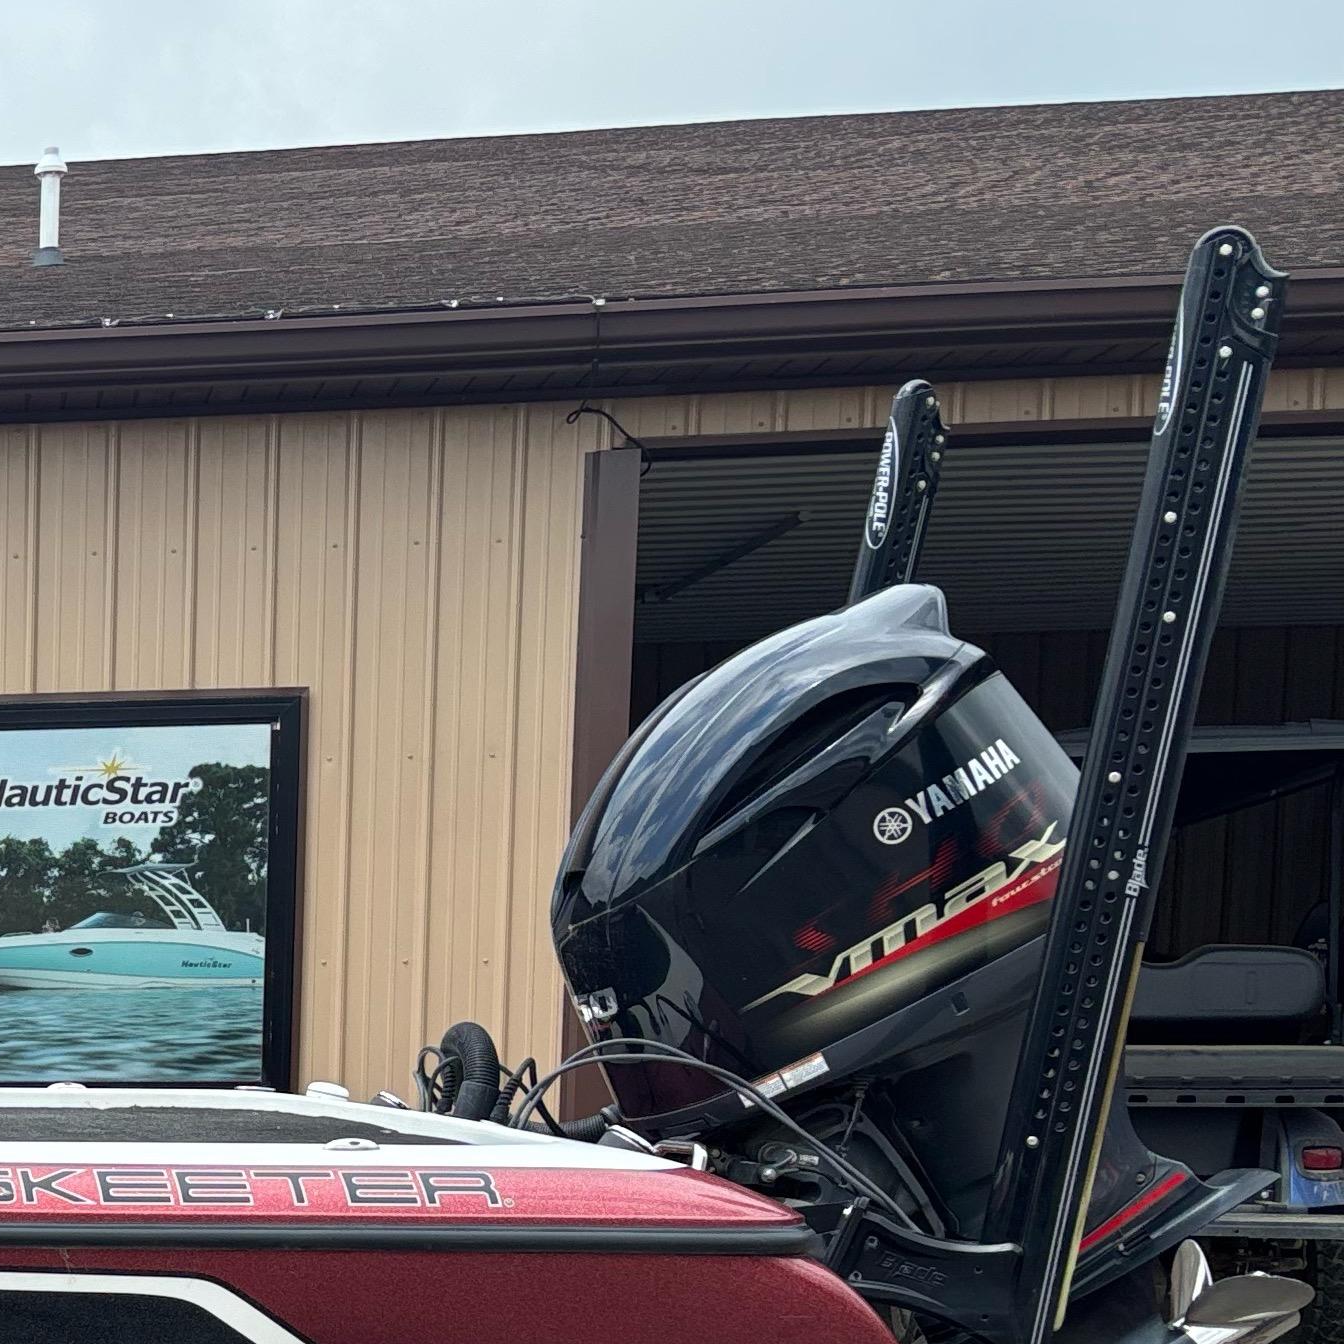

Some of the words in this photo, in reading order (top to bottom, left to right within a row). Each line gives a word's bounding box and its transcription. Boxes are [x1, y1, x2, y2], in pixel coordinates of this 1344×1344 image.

[872, 431, 893, 531] POWER-POLE
[904, 738, 1021, 825] YAMAHA
[103, 810, 174, 825] BOATS
[1125, 848, 1149, 897] Blade
